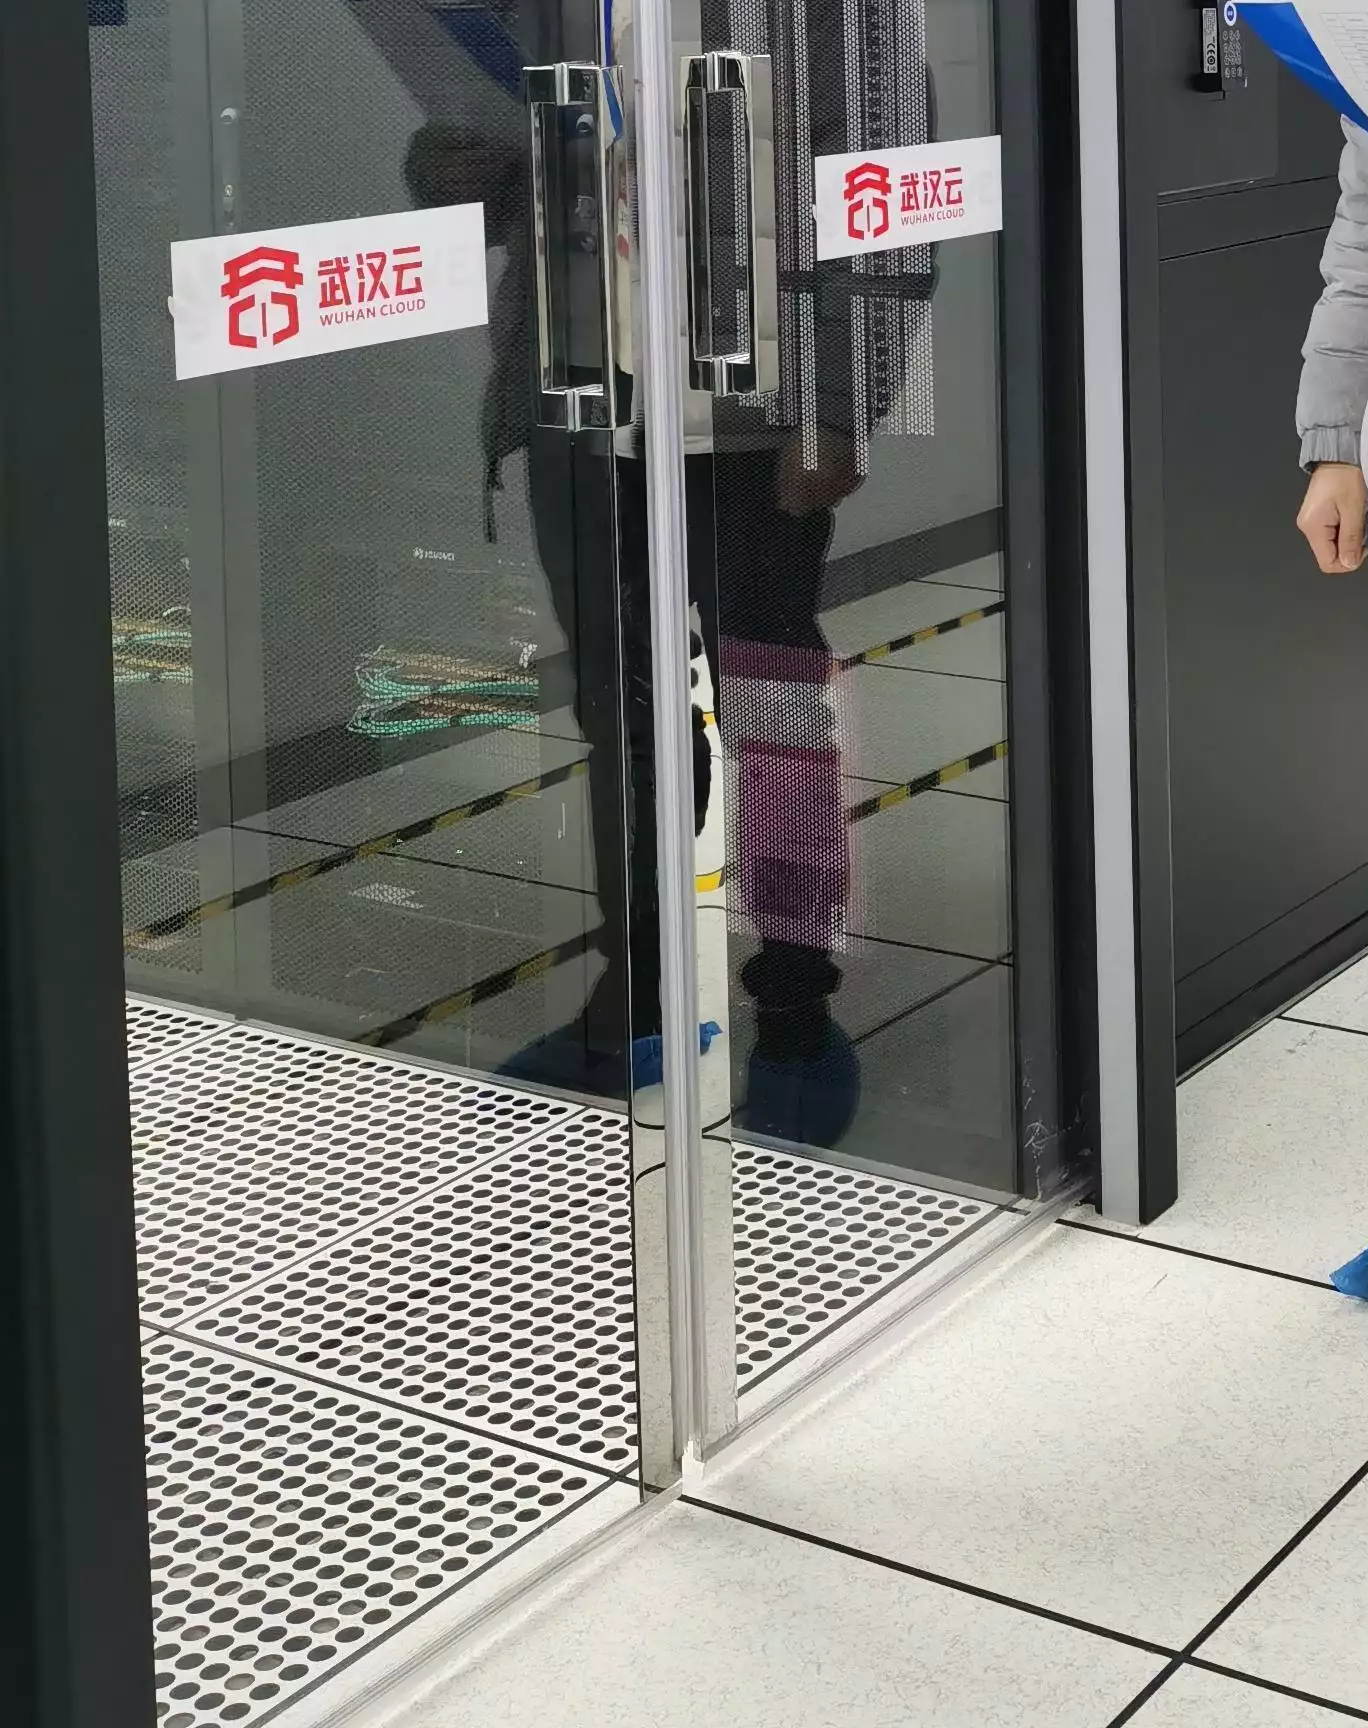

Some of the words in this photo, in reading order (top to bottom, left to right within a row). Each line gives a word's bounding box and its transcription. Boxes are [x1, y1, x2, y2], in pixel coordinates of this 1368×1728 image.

[900, 167, 963, 212] 武汉云
[900, 212, 935, 226] WUHAN
[936, 207, 965, 220] CLOUD
[317, 246, 423, 309] 武汉云
[319, 306, 376, 326] WUHAN
[380, 298, 426, 317] CLOUD
